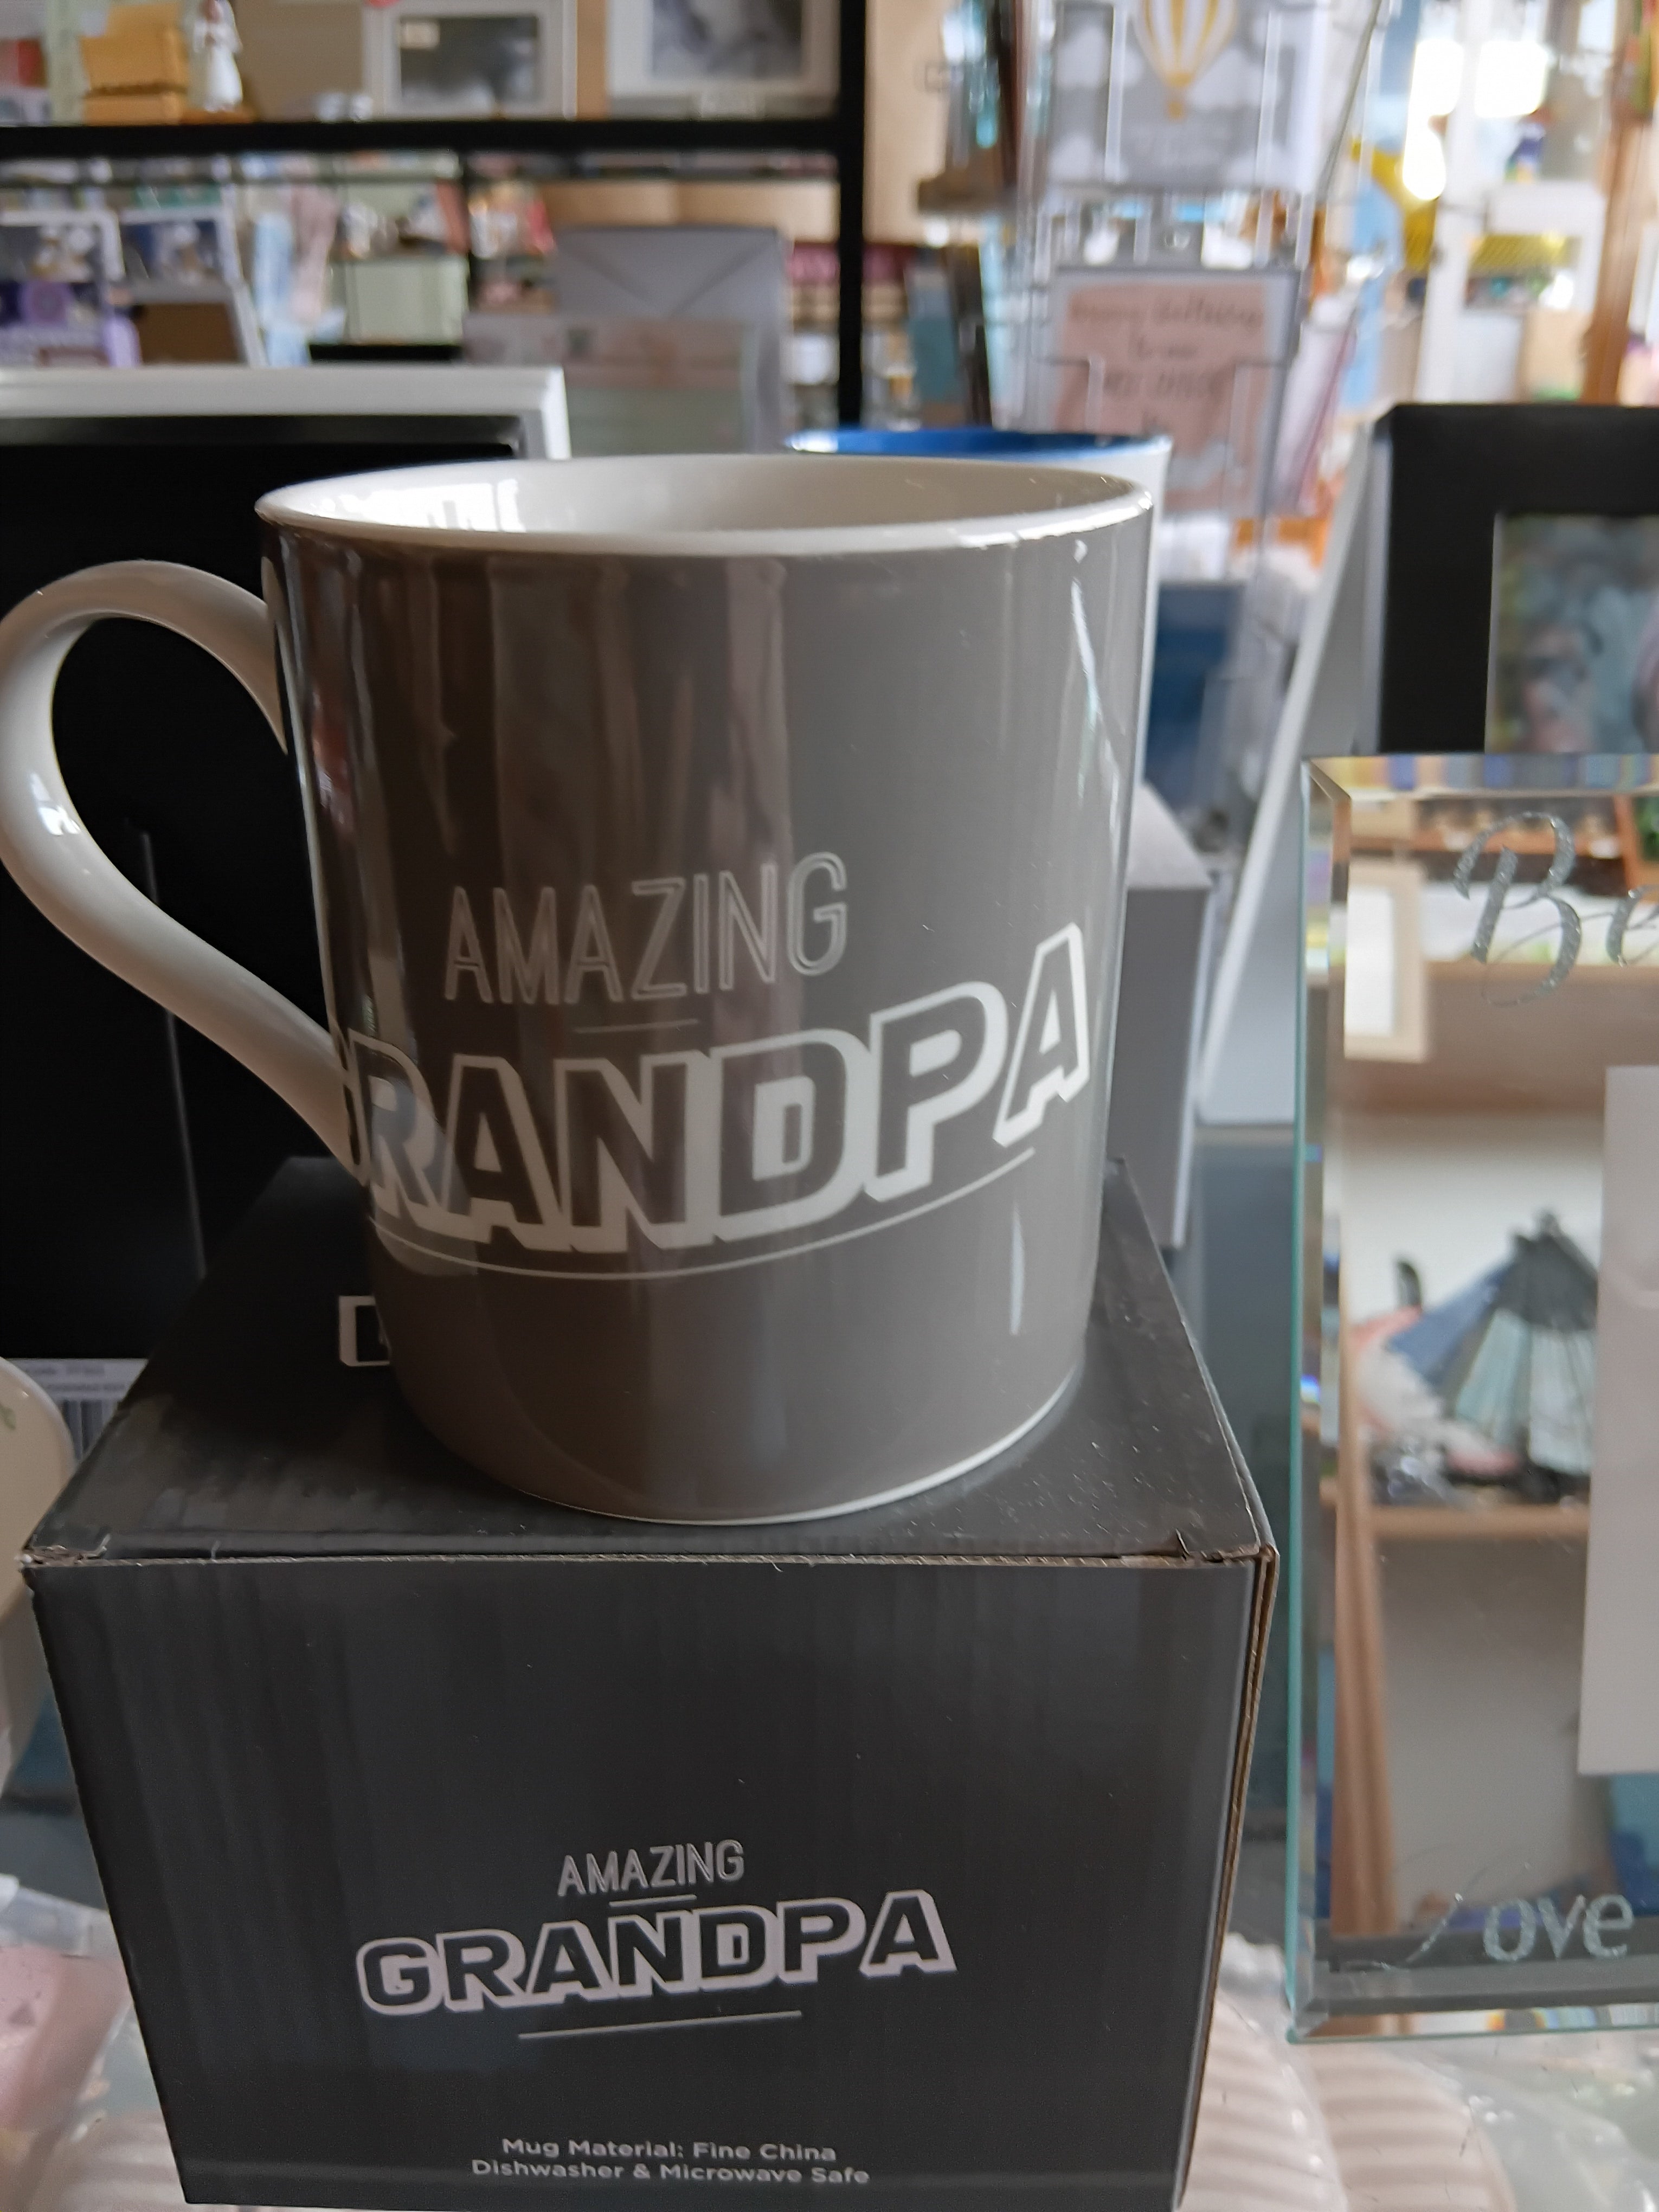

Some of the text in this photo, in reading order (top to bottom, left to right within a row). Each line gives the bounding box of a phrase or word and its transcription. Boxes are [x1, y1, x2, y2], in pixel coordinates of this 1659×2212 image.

[443, 851, 848, 1004] AMAZING
[346, 922, 1090, 1253] RANDPA
[557, 1840, 745, 1897] AMAZING
[355, 1889, 957, 2016] GRANDPA
[471, 2159, 870, 2184] Dishwasher & Microwave Safe
[502, 2138, 837, 2162] Mug Material: Fine China
